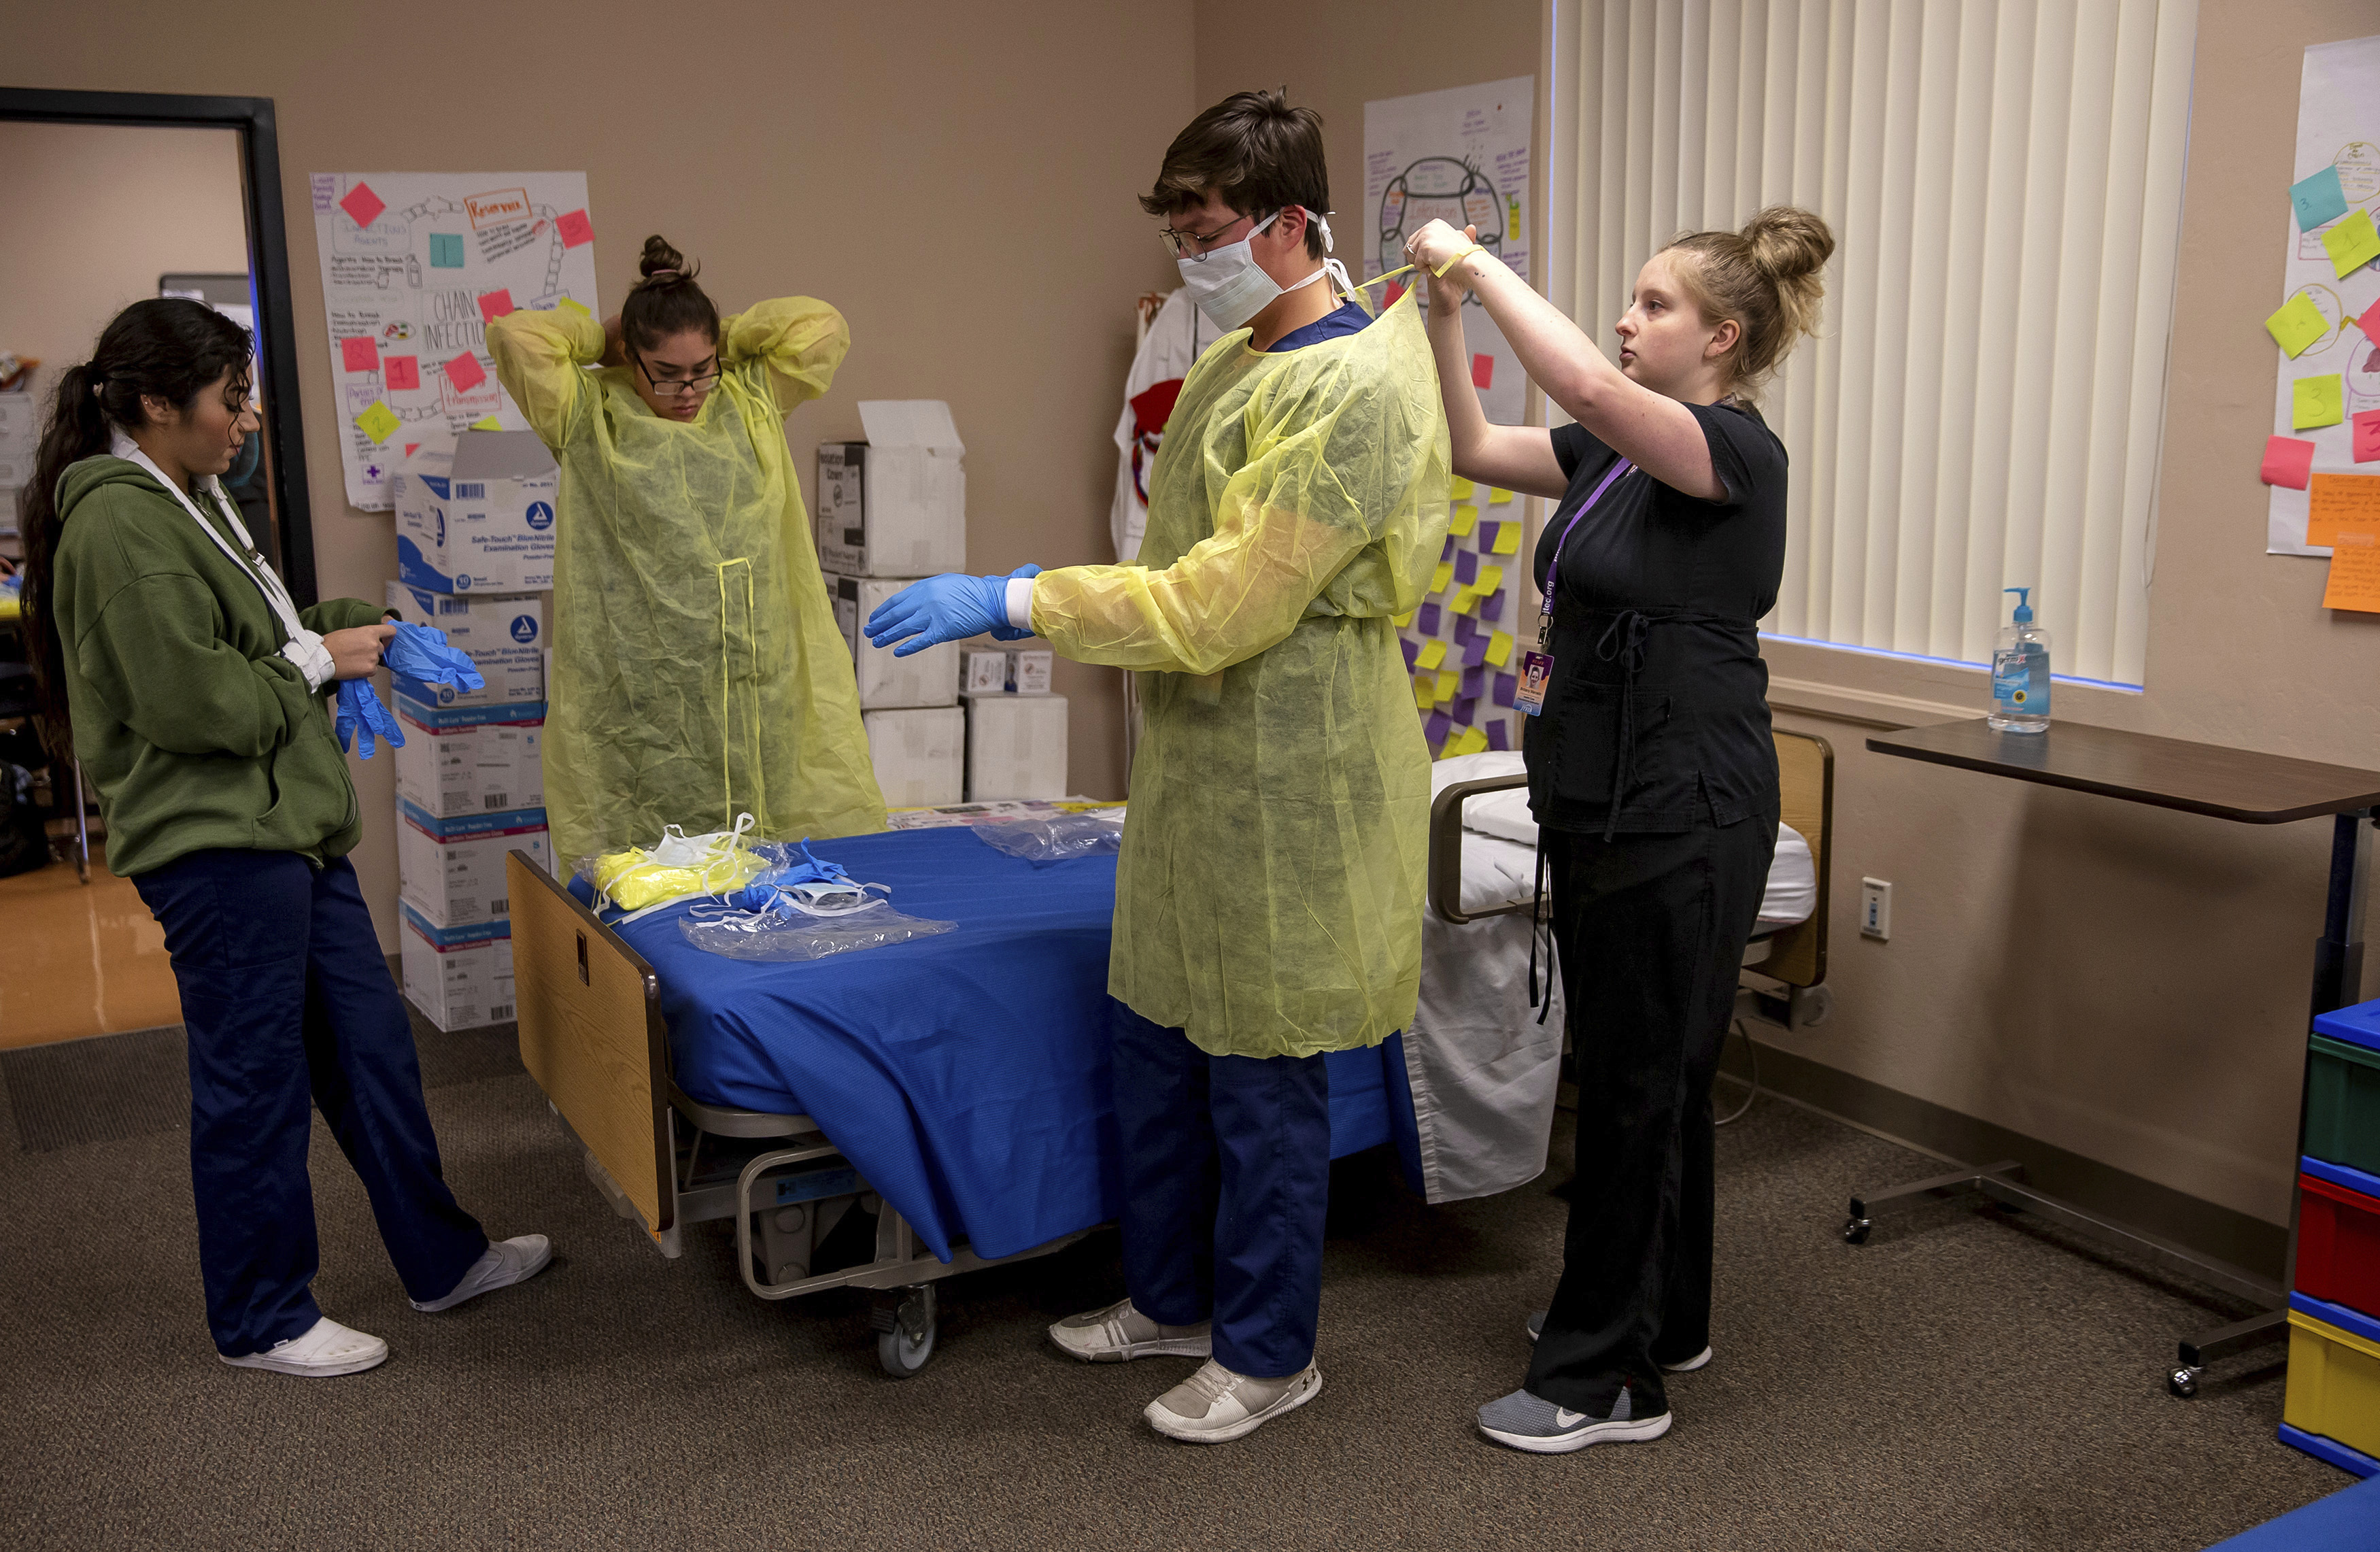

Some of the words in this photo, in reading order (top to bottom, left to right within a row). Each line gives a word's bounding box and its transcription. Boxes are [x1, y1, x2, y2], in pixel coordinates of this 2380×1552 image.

[2299, 198, 2310, 211] 3
[435, 289, 476, 323] CHAIN
[424, 322, 487, 352] INFECTIO
[2308, 386, 2326, 418] 3
[483, 544, 529, 552] Examination
